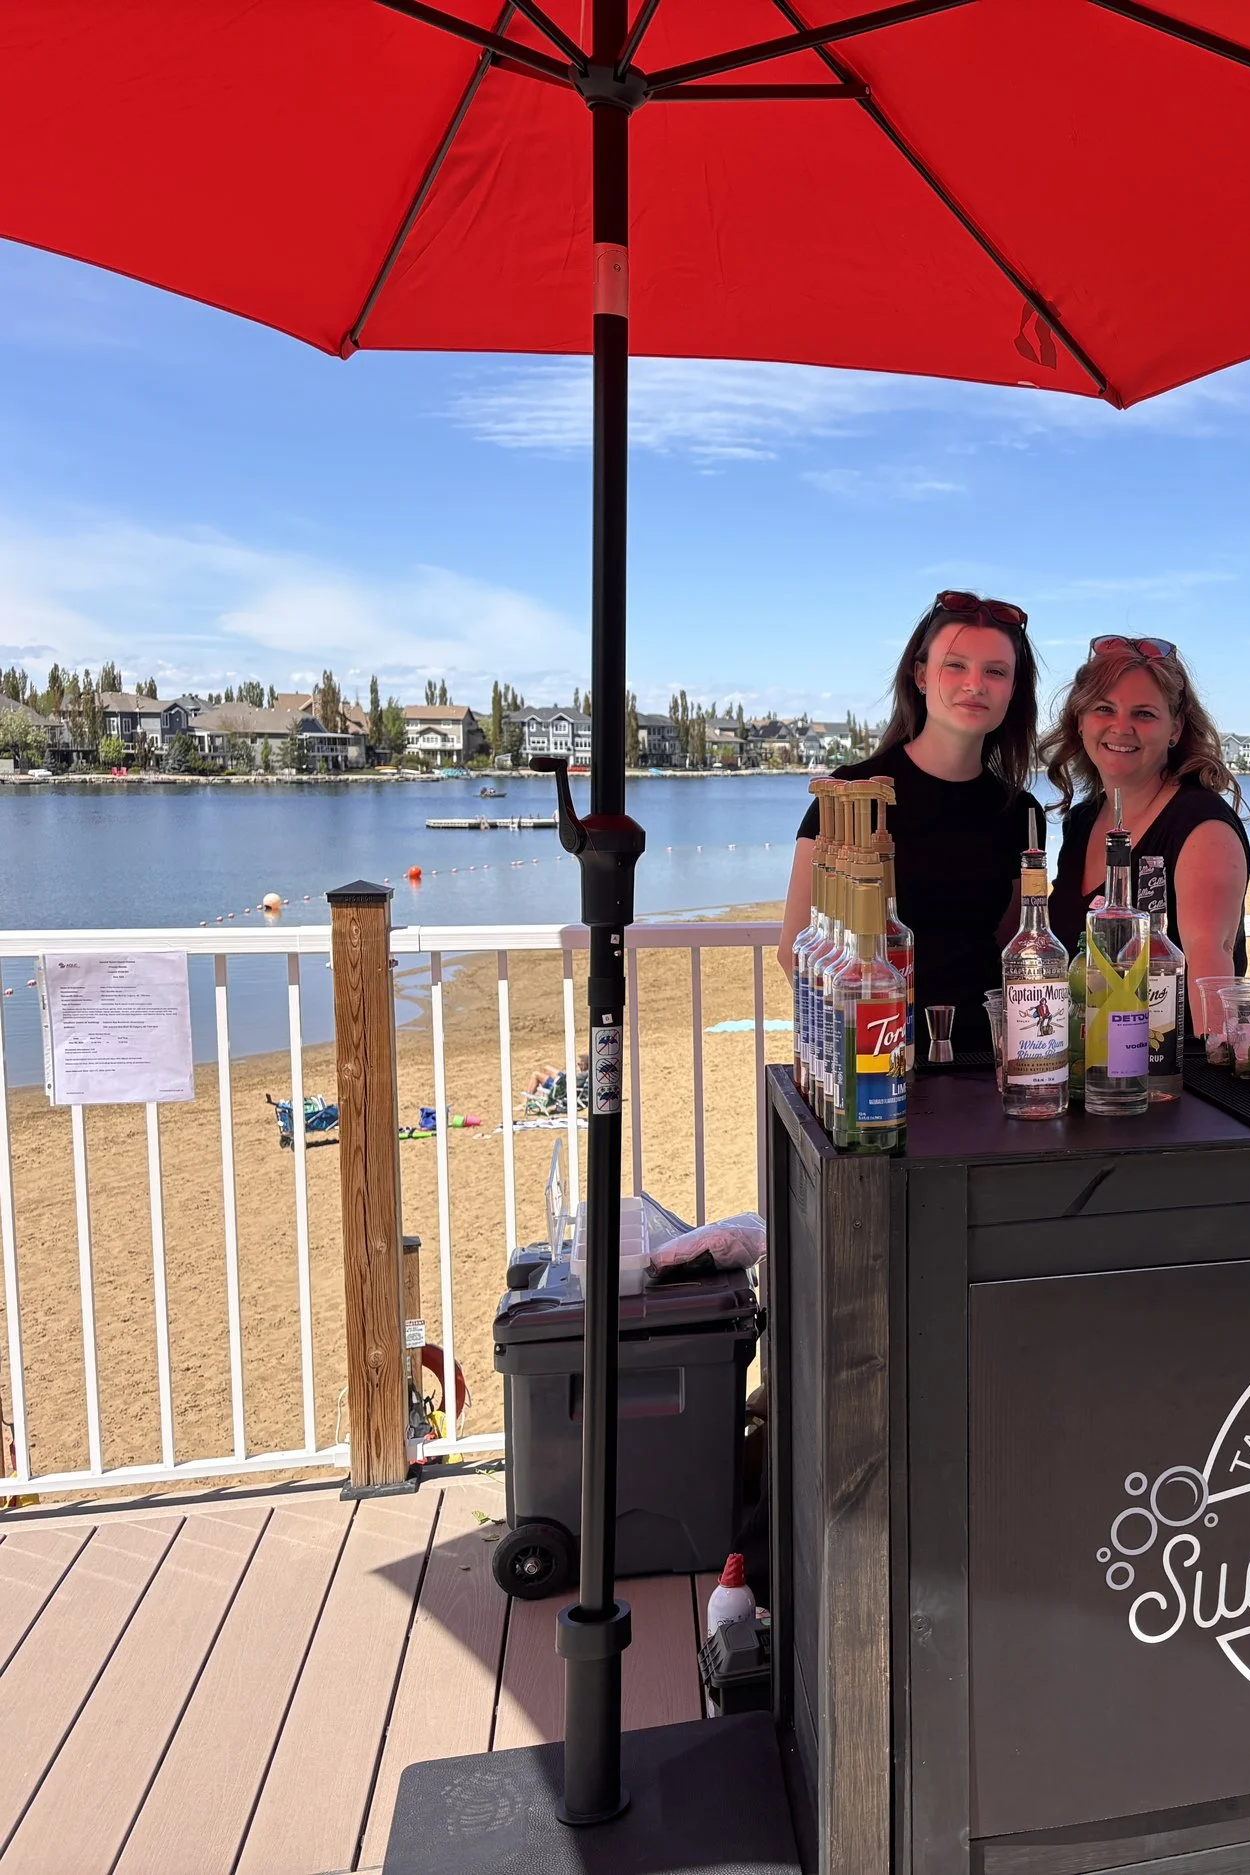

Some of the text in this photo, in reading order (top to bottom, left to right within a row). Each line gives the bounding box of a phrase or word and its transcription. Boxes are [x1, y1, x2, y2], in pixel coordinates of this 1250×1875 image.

[1008, 985, 1069, 1004] Captain Morga
[1112, 1013, 1149, 1023] DETOU
[867, 1013, 906, 1057] Tor
[1019, 1039, 1064, 1049] White Rum
[1149, 1055, 1164, 1063] RUP
[892, 1082, 906, 1096] LIM
